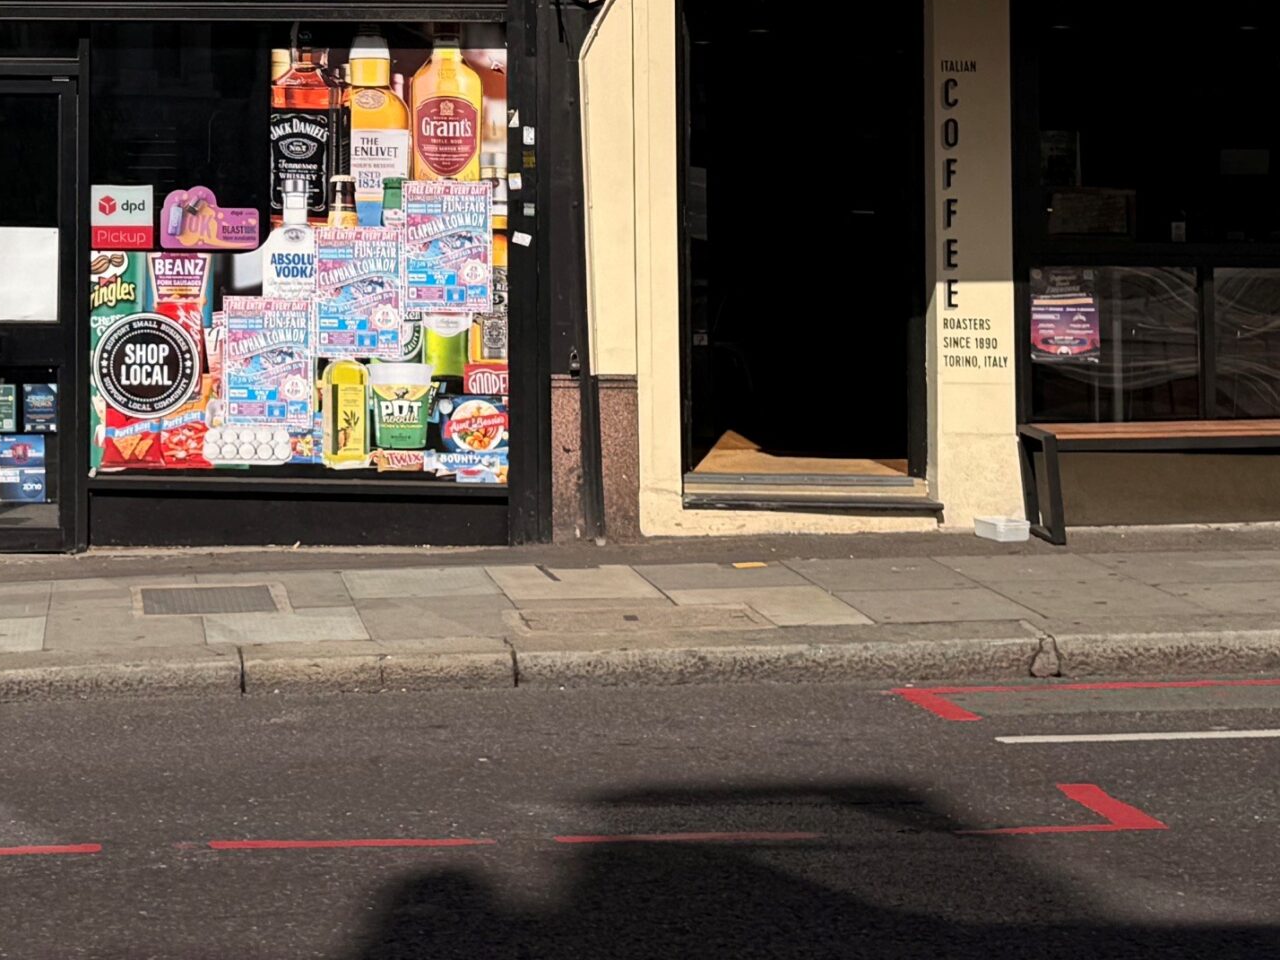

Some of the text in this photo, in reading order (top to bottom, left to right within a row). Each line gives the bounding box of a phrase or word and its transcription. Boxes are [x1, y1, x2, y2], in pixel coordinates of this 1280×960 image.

[941, 60, 977, 73] ITALIAN
[270, 118, 330, 142] JACK DANIEL'S
[421, 117, 472, 137] Grant's
[360, 137, 379, 146] THE
[352, 147, 399, 158] ENLIVET
[278, 159, 318, 170] Tennessee
[279, 172, 318, 181] WHISKEY
[358, 179, 381, 189] 1824
[942, 78, 959, 309] COFFEE
[121, 200, 146, 214] dpd
[408, 212, 486, 240] CLAPHAM COMMON
[97, 230, 146, 246] Pickup
[154, 258, 204, 276] BEANZ
[271, 253, 314, 266] ABSOLU
[320, 258, 397, 285] CLAPHAM COMMON
[90, 277, 136, 310] ringles
[943, 318, 991, 331] ROASTERS
[104, 324, 131, 351] SUPPORT
[132, 320, 158, 329] SMALL
[229, 328, 306, 356] CLAPHAM COMMON
[943, 336, 998, 350] SINCE 1890
[124, 343, 170, 364] SHOP
[943, 355, 1008, 370] TORINO, ITALY
[120, 364, 173, 386] LOCAL
[103, 376, 189, 411] SUPPORT LOCAL COMMUNITY
[380, 400, 422, 417] POT
[386, 453, 423, 468] TWIX
[440, 454, 480, 464] BOUNTY
